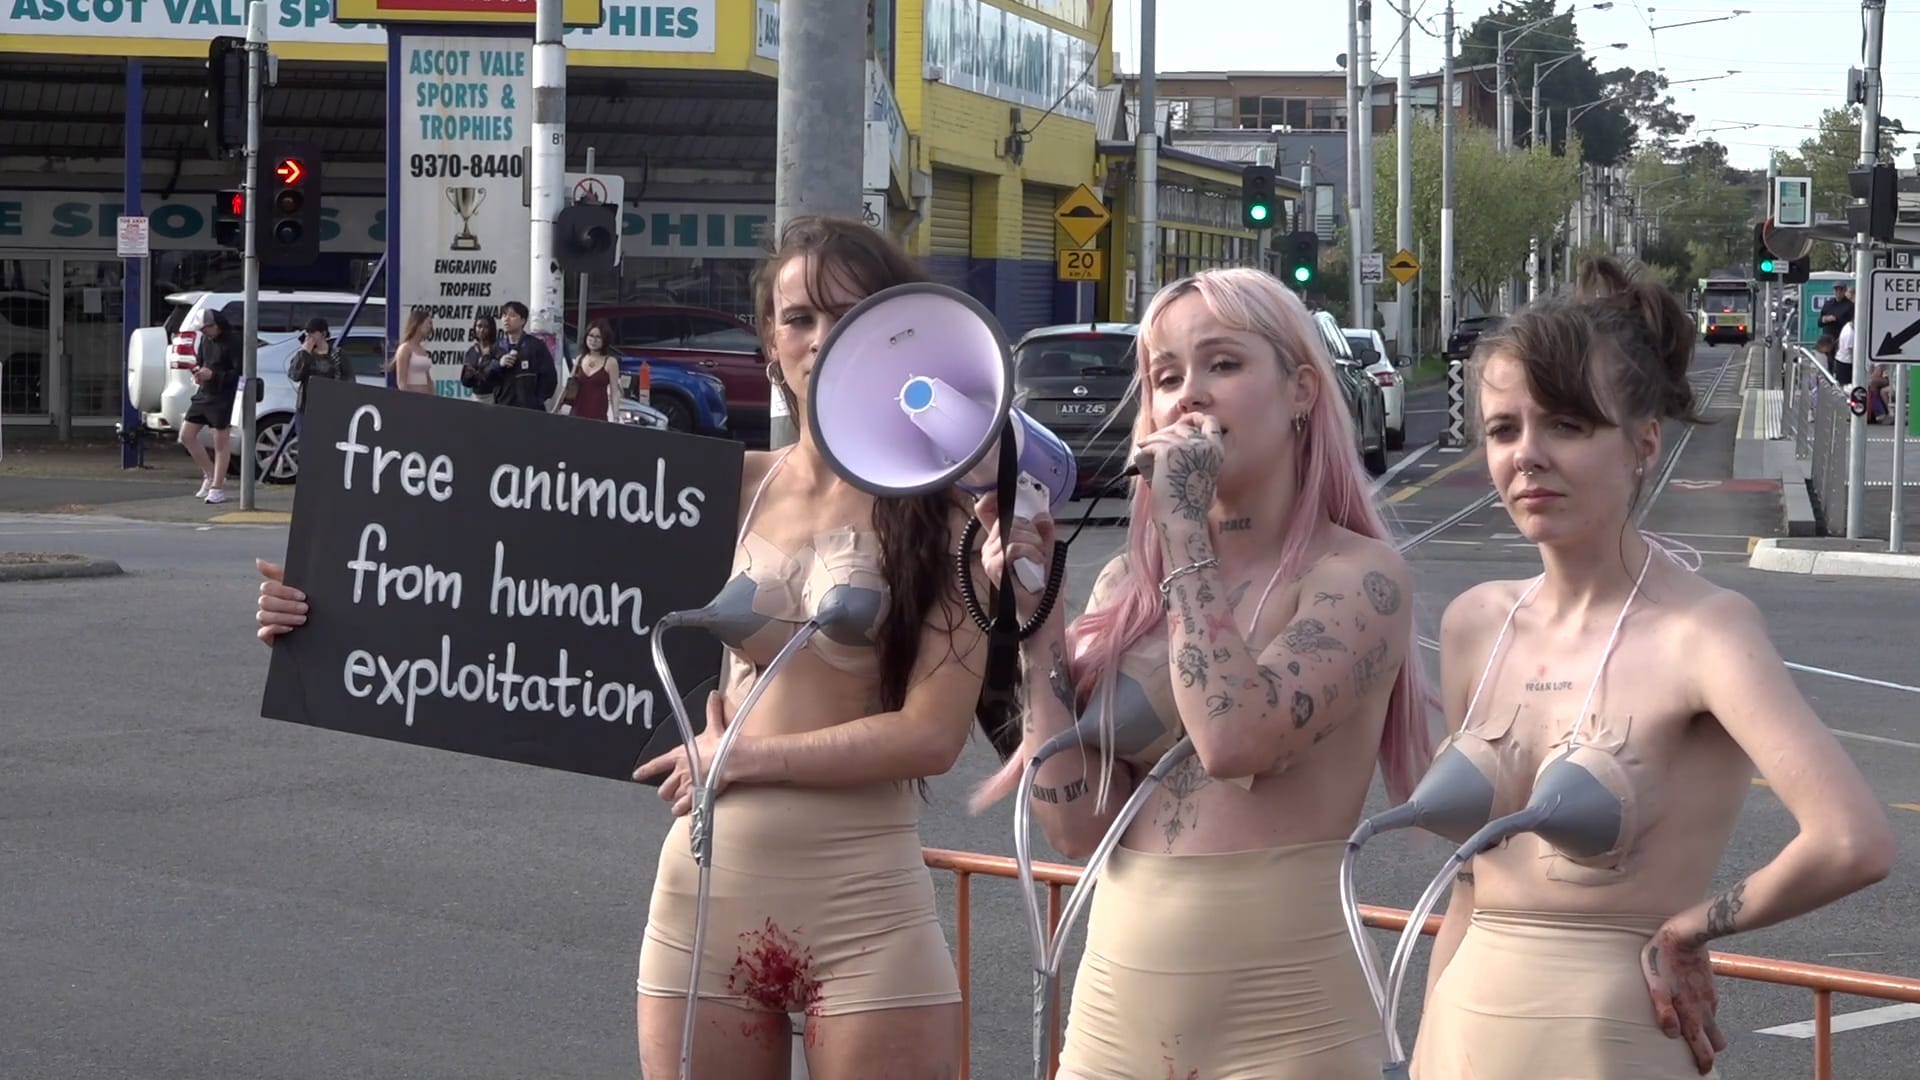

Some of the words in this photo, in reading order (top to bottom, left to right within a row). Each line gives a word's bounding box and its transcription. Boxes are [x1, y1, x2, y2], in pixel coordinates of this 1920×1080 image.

[10, 0, 148, 23] ASCOT
[409, 49, 470, 76] ASCOT
[480, 50, 525, 76] VALE
[416, 82, 488, 108] SPORTS
[501, 83, 516, 109] &
[420, 114, 513, 141] TROPHIES
[410, 153, 523, 178] 9370-8440
[434, 259, 497, 275] ENGRAVING
[1067, 252, 1095, 269] 20
[439, 282, 492, 297] TROPHIES
[424, 327, 465, 343] ONOUR
[335, 404, 455, 502] free
[489, 457, 705, 530] animals
[347, 523, 463, 609] from
[489, 540, 651, 635] human
[343, 634, 654, 730] exploitation
